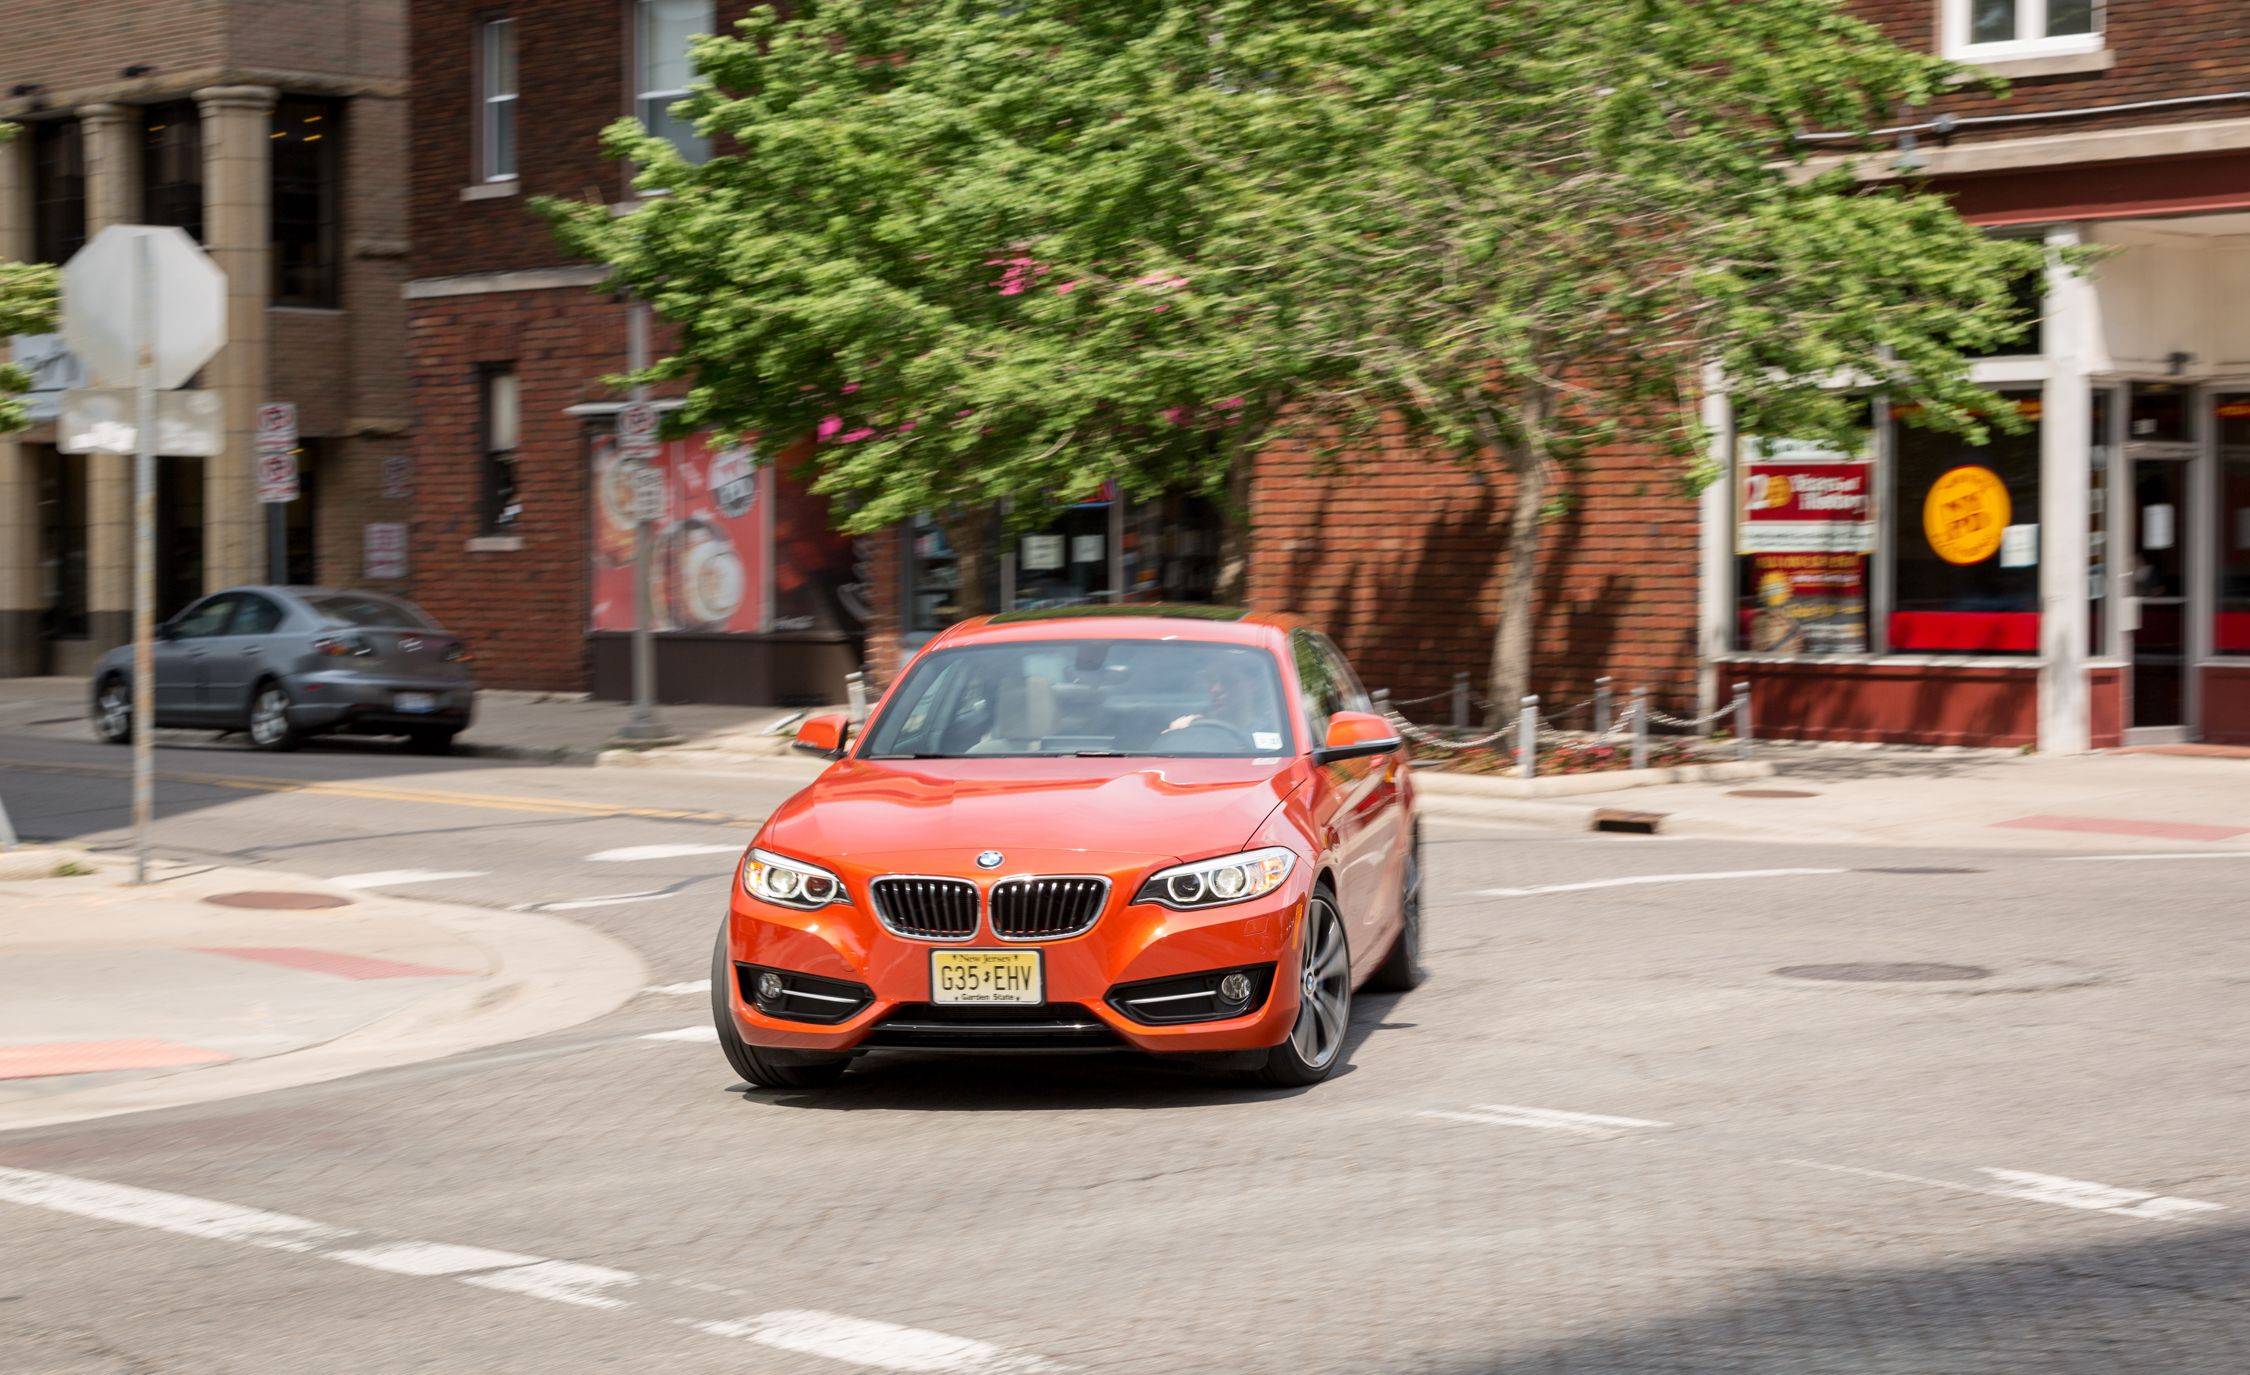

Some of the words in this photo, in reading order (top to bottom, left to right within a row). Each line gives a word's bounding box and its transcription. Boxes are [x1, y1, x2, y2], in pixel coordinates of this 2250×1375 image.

[941, 965, 980, 991] G35
[994, 965, 1032, 991] EHV
[961, 993, 990, 1001] Garden
[993, 993, 1014, 1001] State
